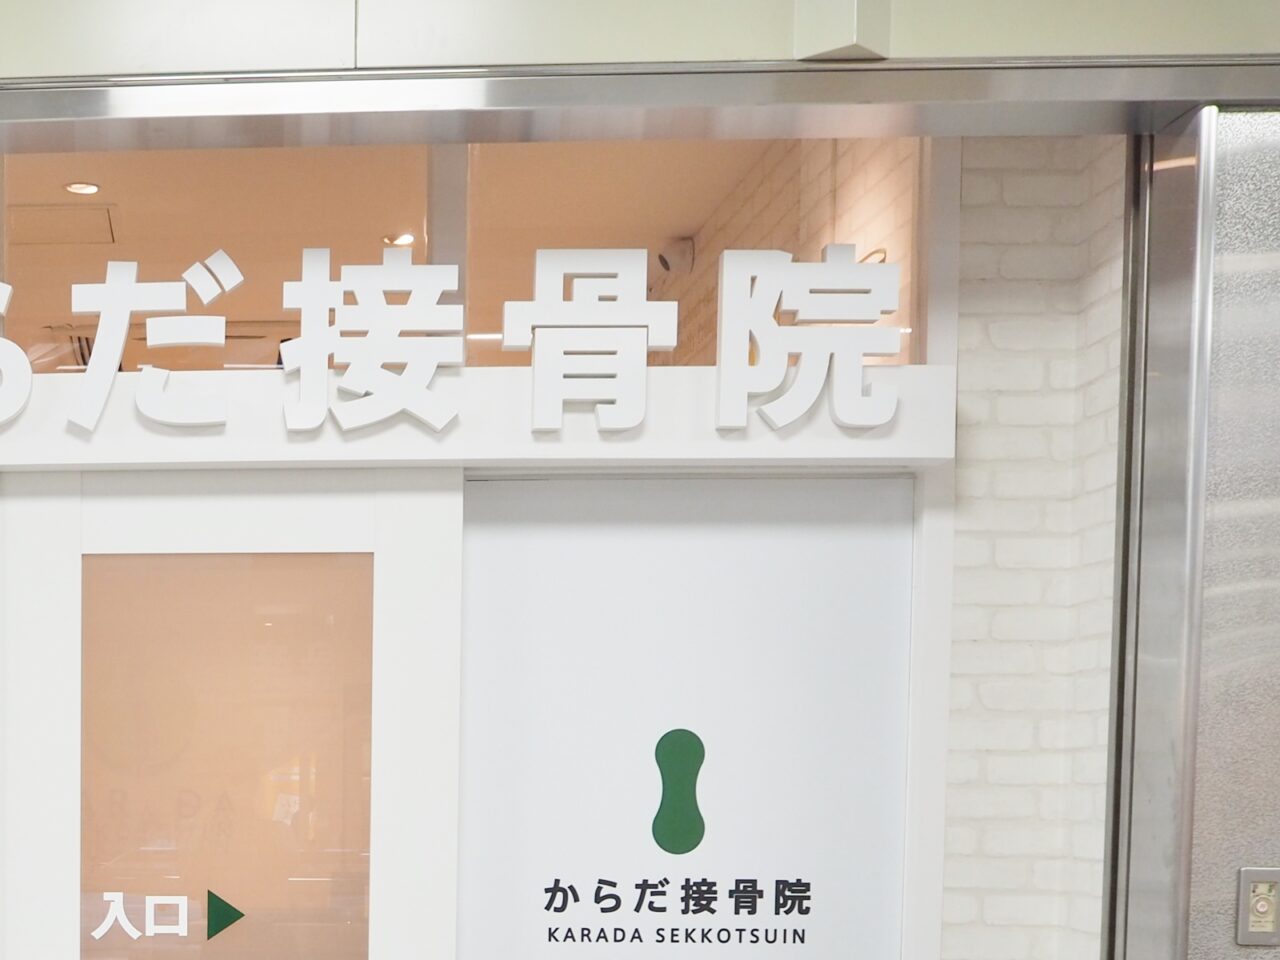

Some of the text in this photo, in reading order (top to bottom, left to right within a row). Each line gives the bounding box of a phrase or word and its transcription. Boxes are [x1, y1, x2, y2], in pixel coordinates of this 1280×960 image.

[90, 892, 188, 940] 入口
[544, 877, 812, 916] からだ接骨院
[548, 927, 806, 945] KARADA SEKKOTSUIN
